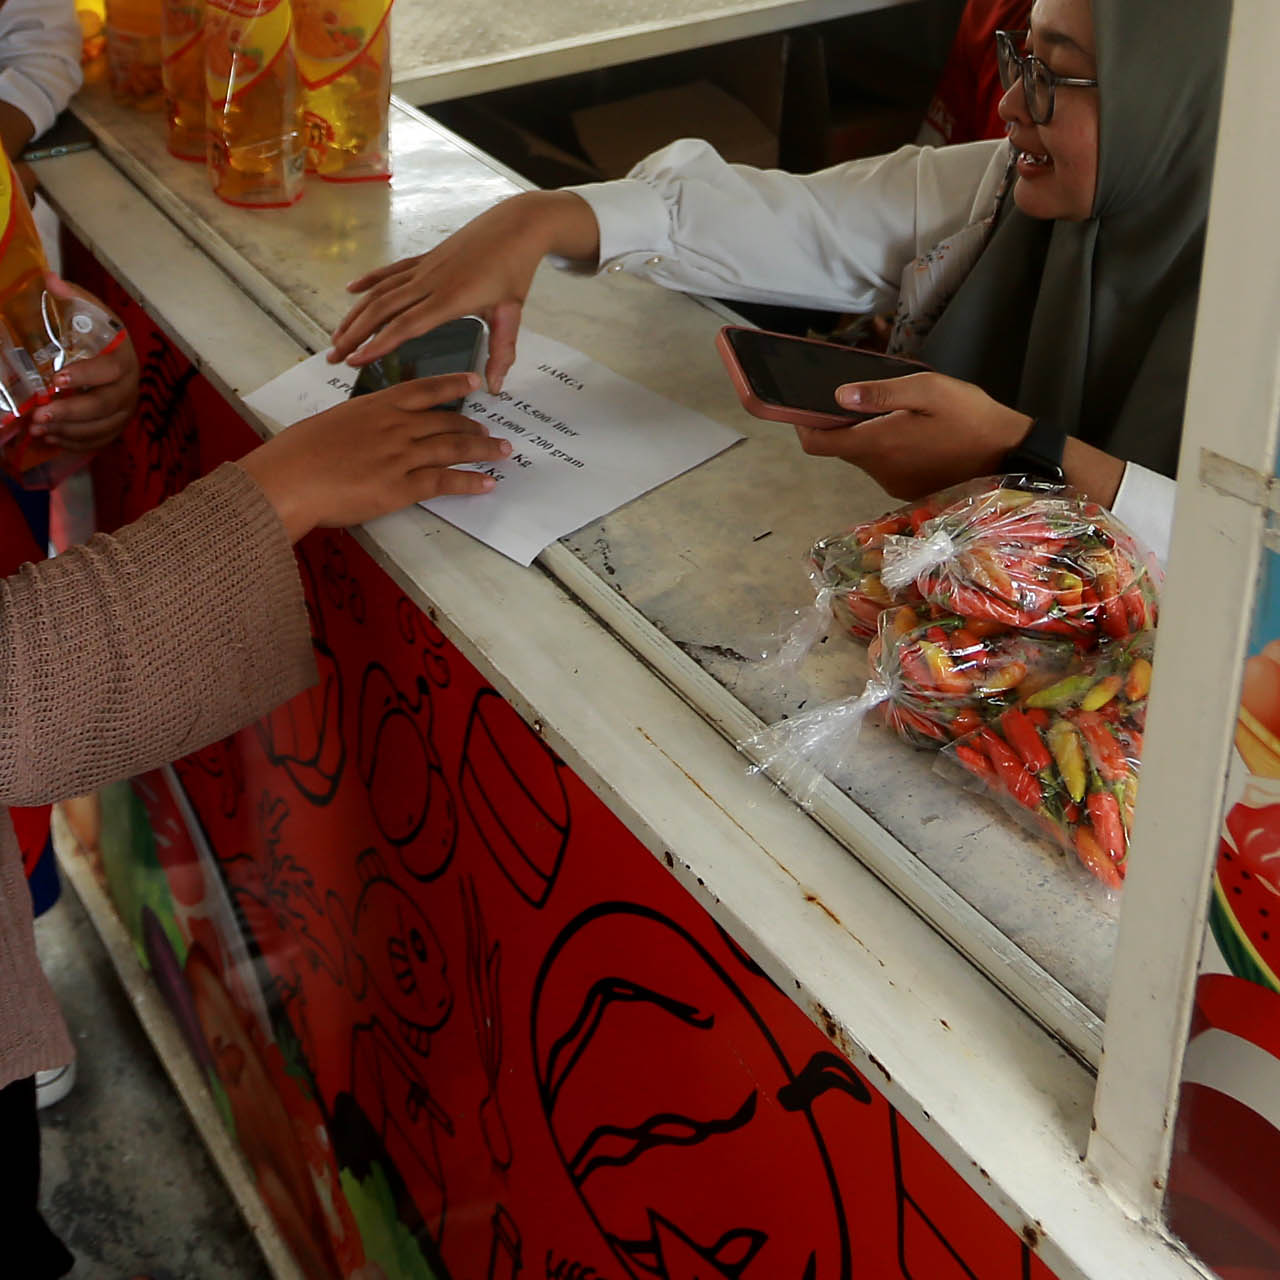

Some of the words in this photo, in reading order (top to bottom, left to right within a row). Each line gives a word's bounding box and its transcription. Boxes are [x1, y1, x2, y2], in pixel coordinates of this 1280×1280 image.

[537, 363, 585, 391] HARGA
[468, 402, 487, 414] Rp
[529, 434, 555, 451] 200
[549, 448, 586, 469] gram
[552, 420, 581, 437] liter
[512, 452, 533, 469] Kg
[484, 467, 506, 482] Kg
